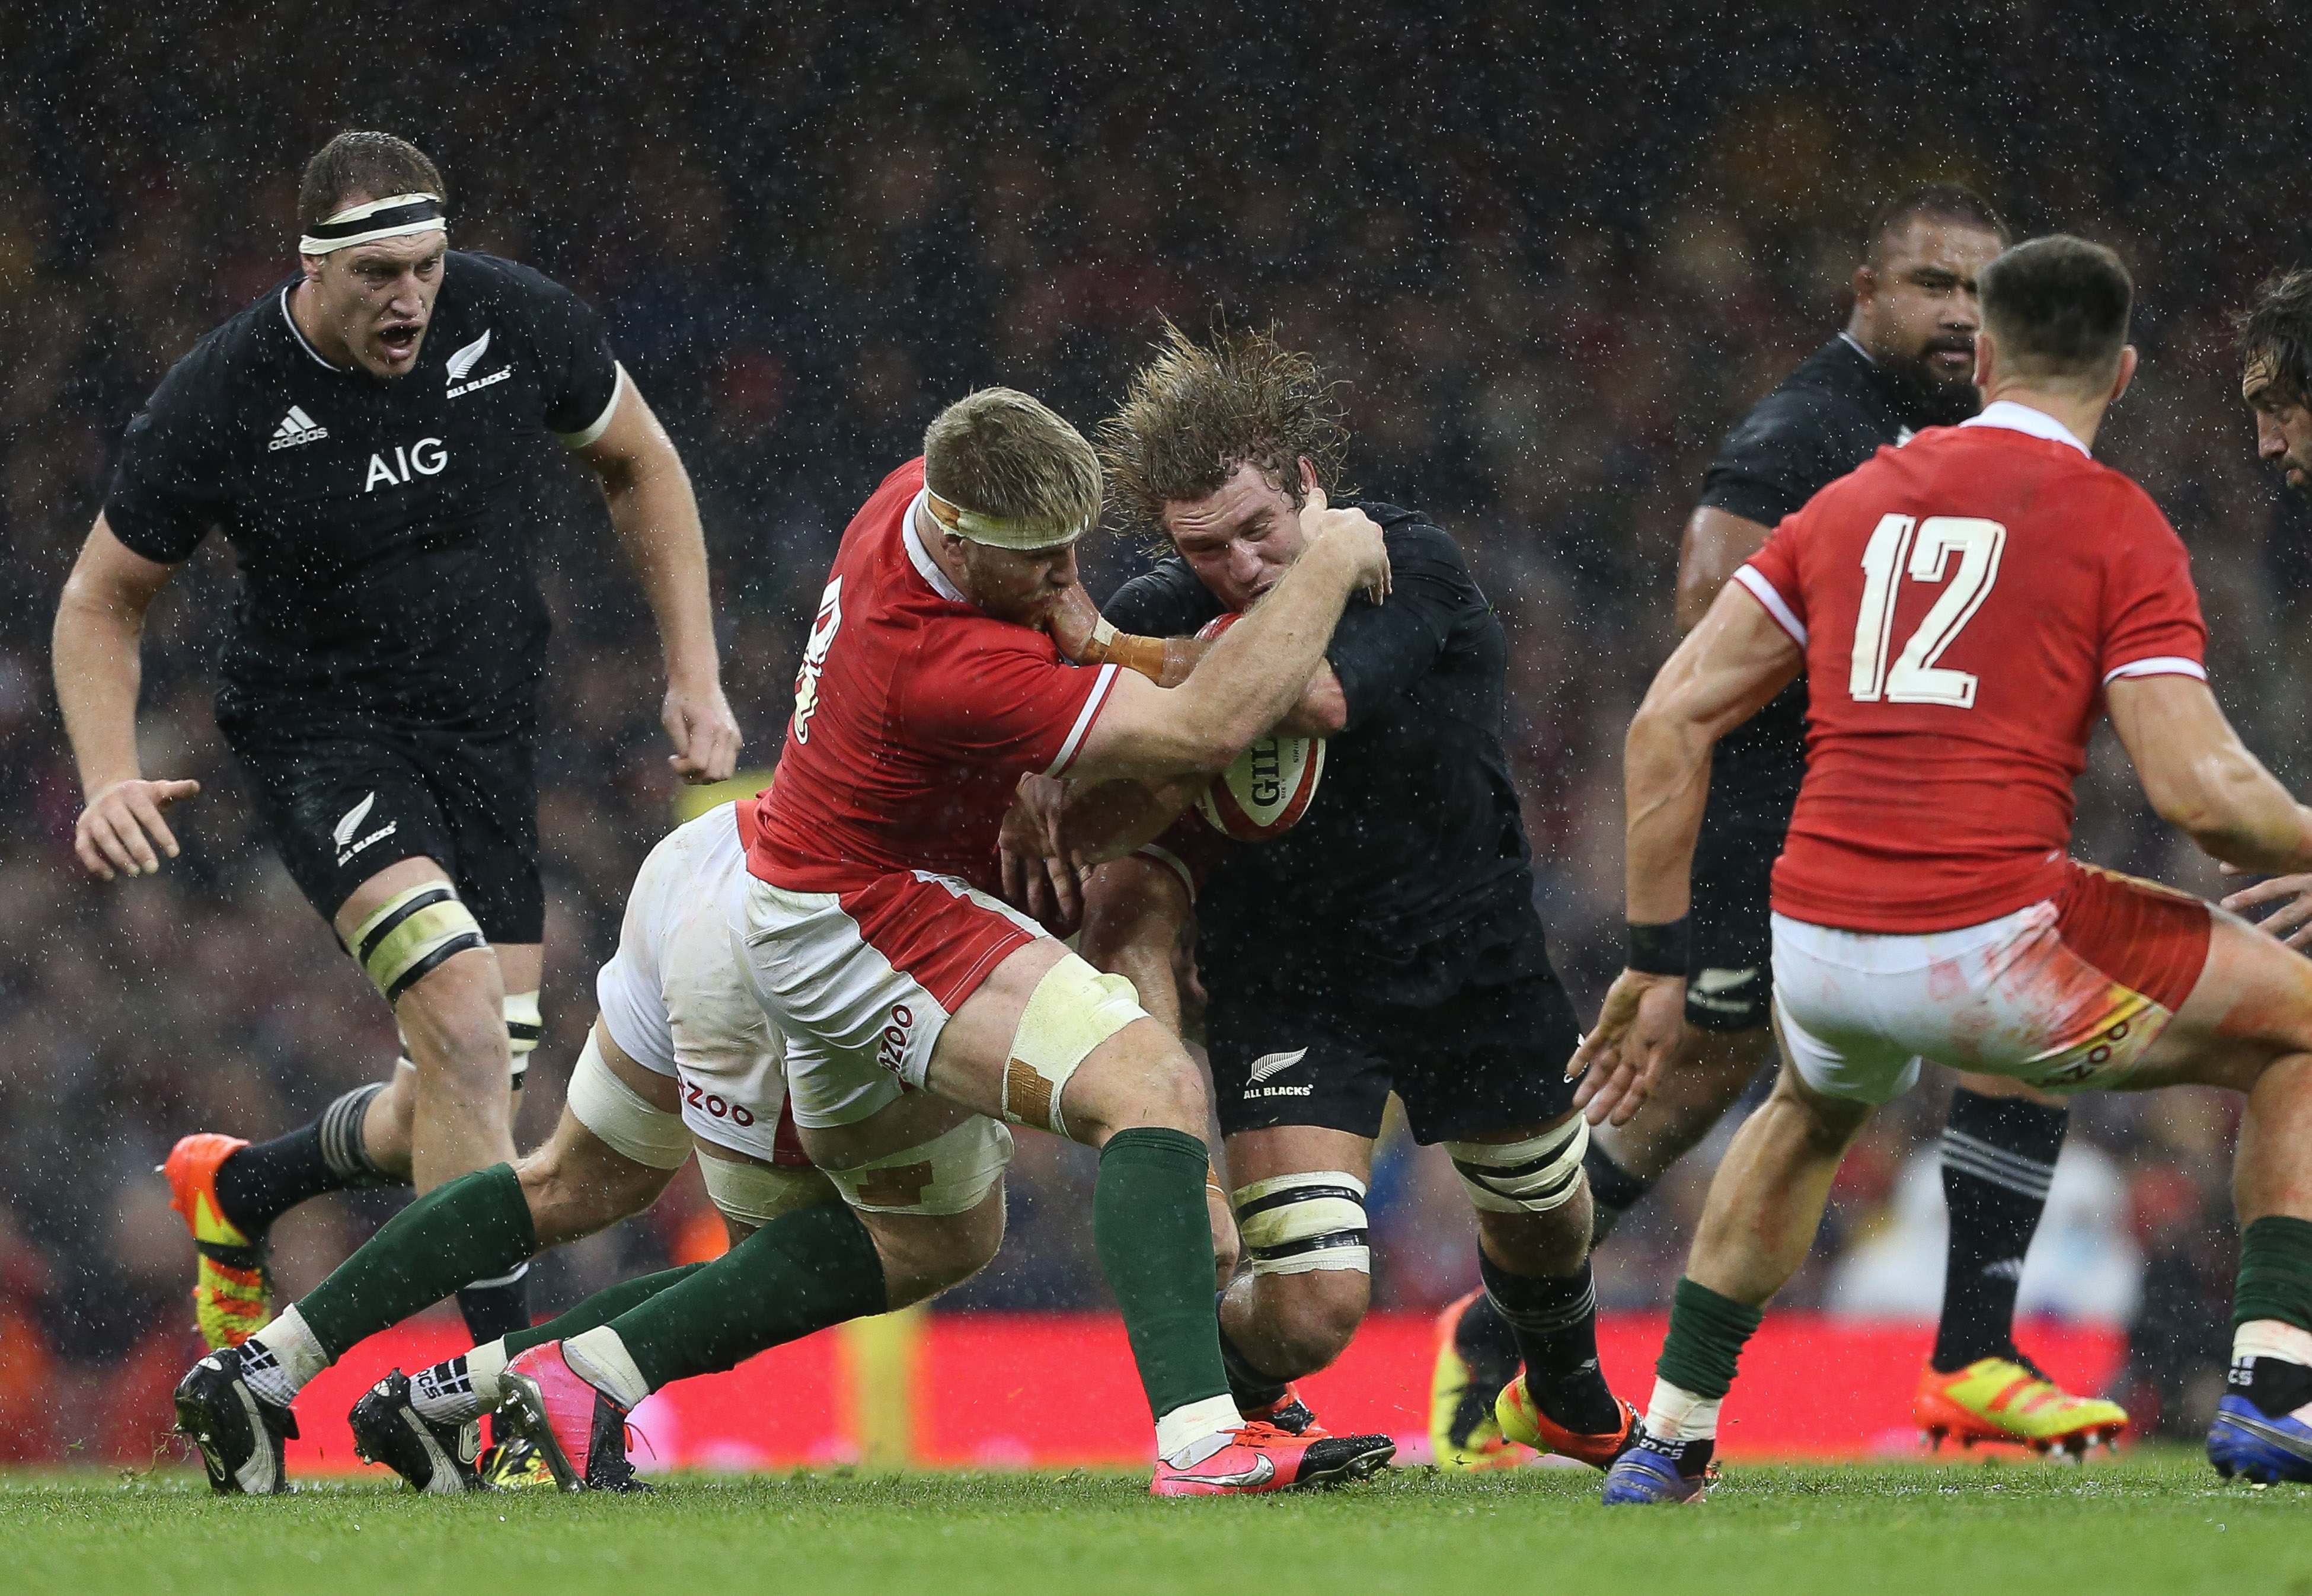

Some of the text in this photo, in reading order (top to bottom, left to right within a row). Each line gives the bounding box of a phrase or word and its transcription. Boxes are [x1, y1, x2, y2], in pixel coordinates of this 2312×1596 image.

[446, 385, 468, 399] ALL
[268, 427, 328, 450] adidas
[364, 437, 448, 492] AIG
[1848, 512, 2007, 709] 12
[1243, 1086, 1311, 1099] ALL BLACKS
